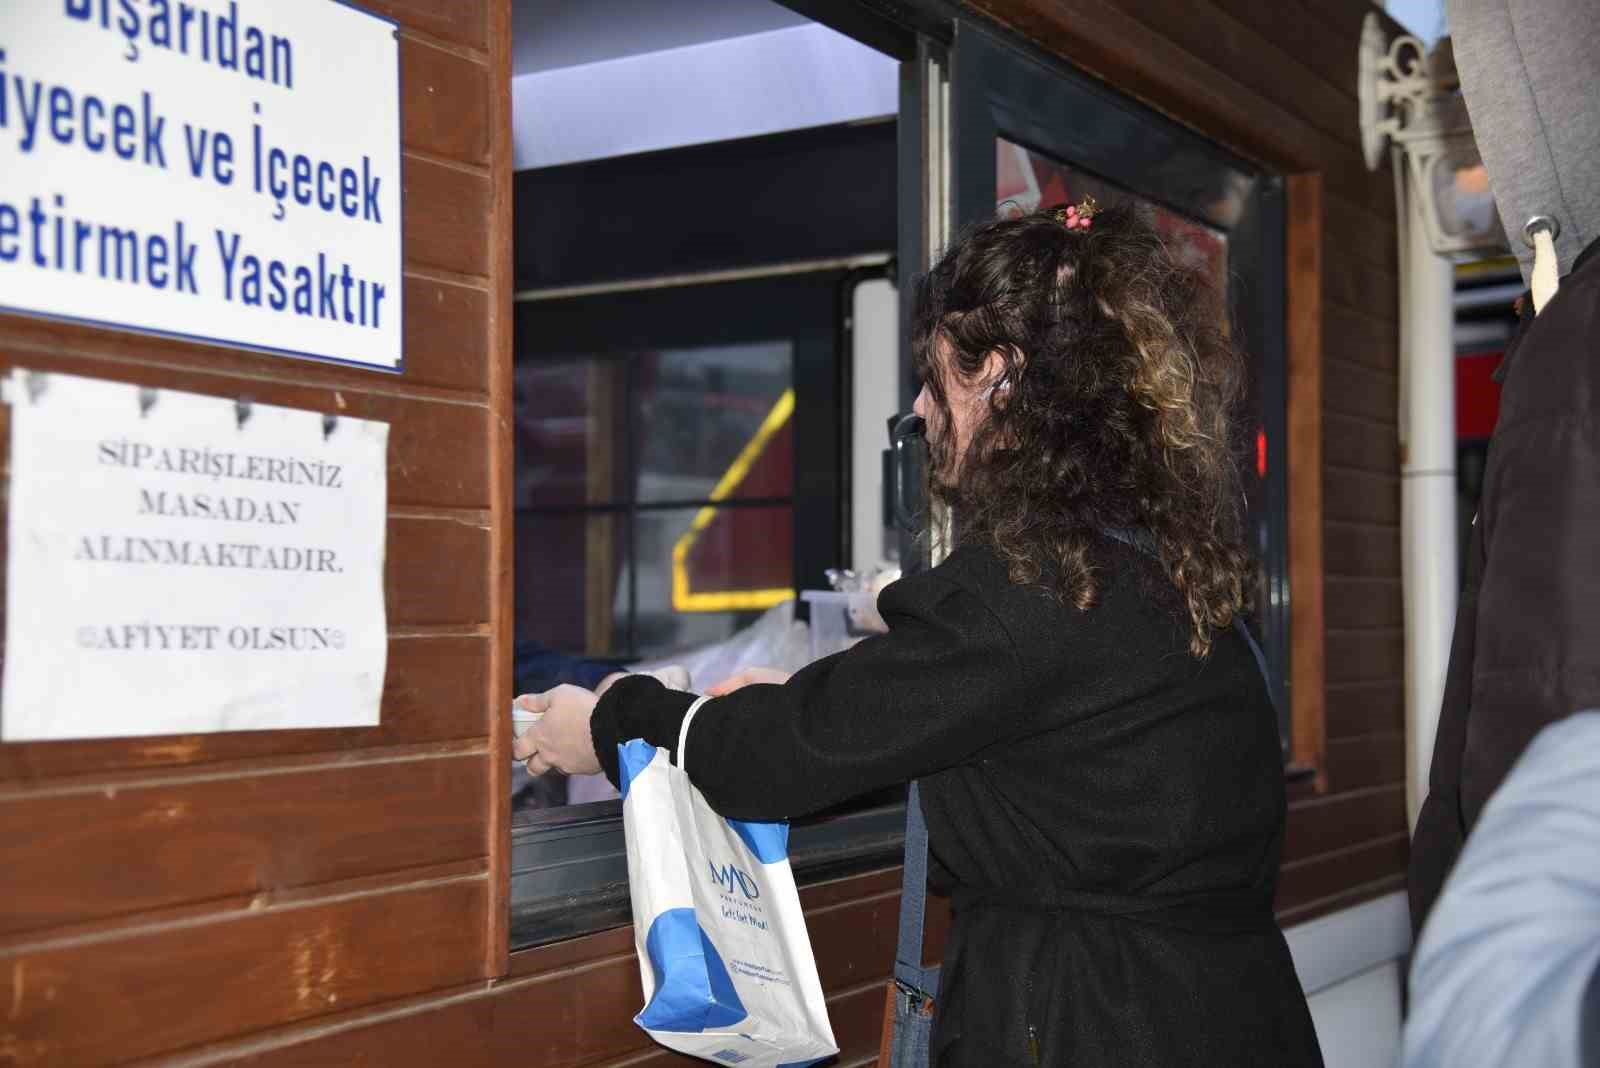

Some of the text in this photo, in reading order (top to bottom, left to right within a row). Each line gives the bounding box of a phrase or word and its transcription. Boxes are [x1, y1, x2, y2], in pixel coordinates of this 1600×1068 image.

[183, 123, 235, 187] ve
[252, 102, 383, 224] İçecek
[215, 229, 386, 329] Yasaktır
[98, 441, 343, 489] SİPARİŞLERİNİZ
[138, 488, 301, 526] MASADAN
[74, 533, 345, 574] ALINMAKTADIR.
[98, 619, 330, 651] AFİYET OLSUN
